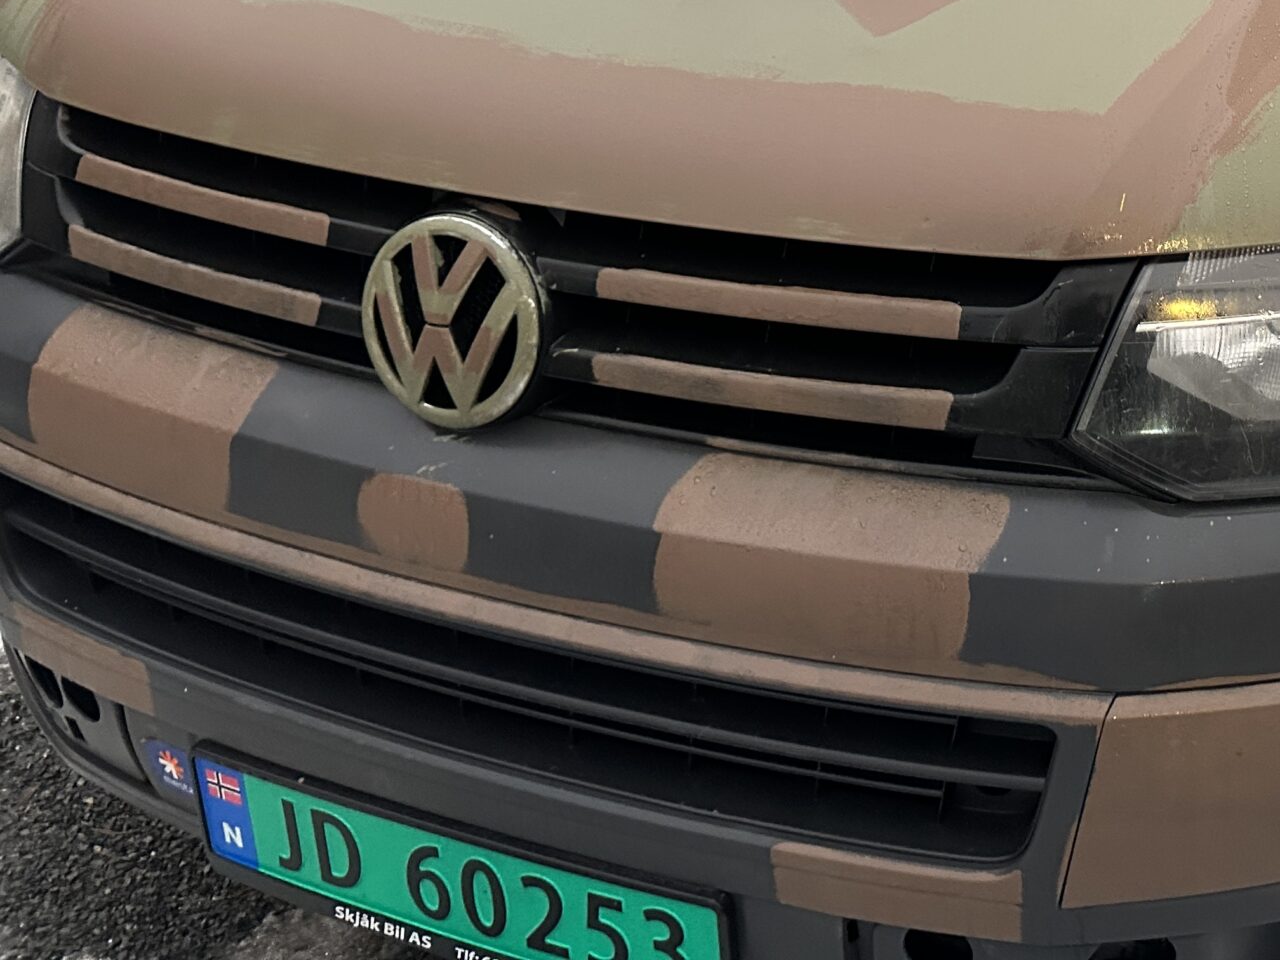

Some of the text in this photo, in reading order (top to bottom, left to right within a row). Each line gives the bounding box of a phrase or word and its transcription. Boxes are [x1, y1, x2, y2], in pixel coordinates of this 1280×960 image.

[222, 821, 244, 848] N
[279, 798, 687, 960] JD 60253
[335, 906, 432, 948] Skjåk Bil AS
